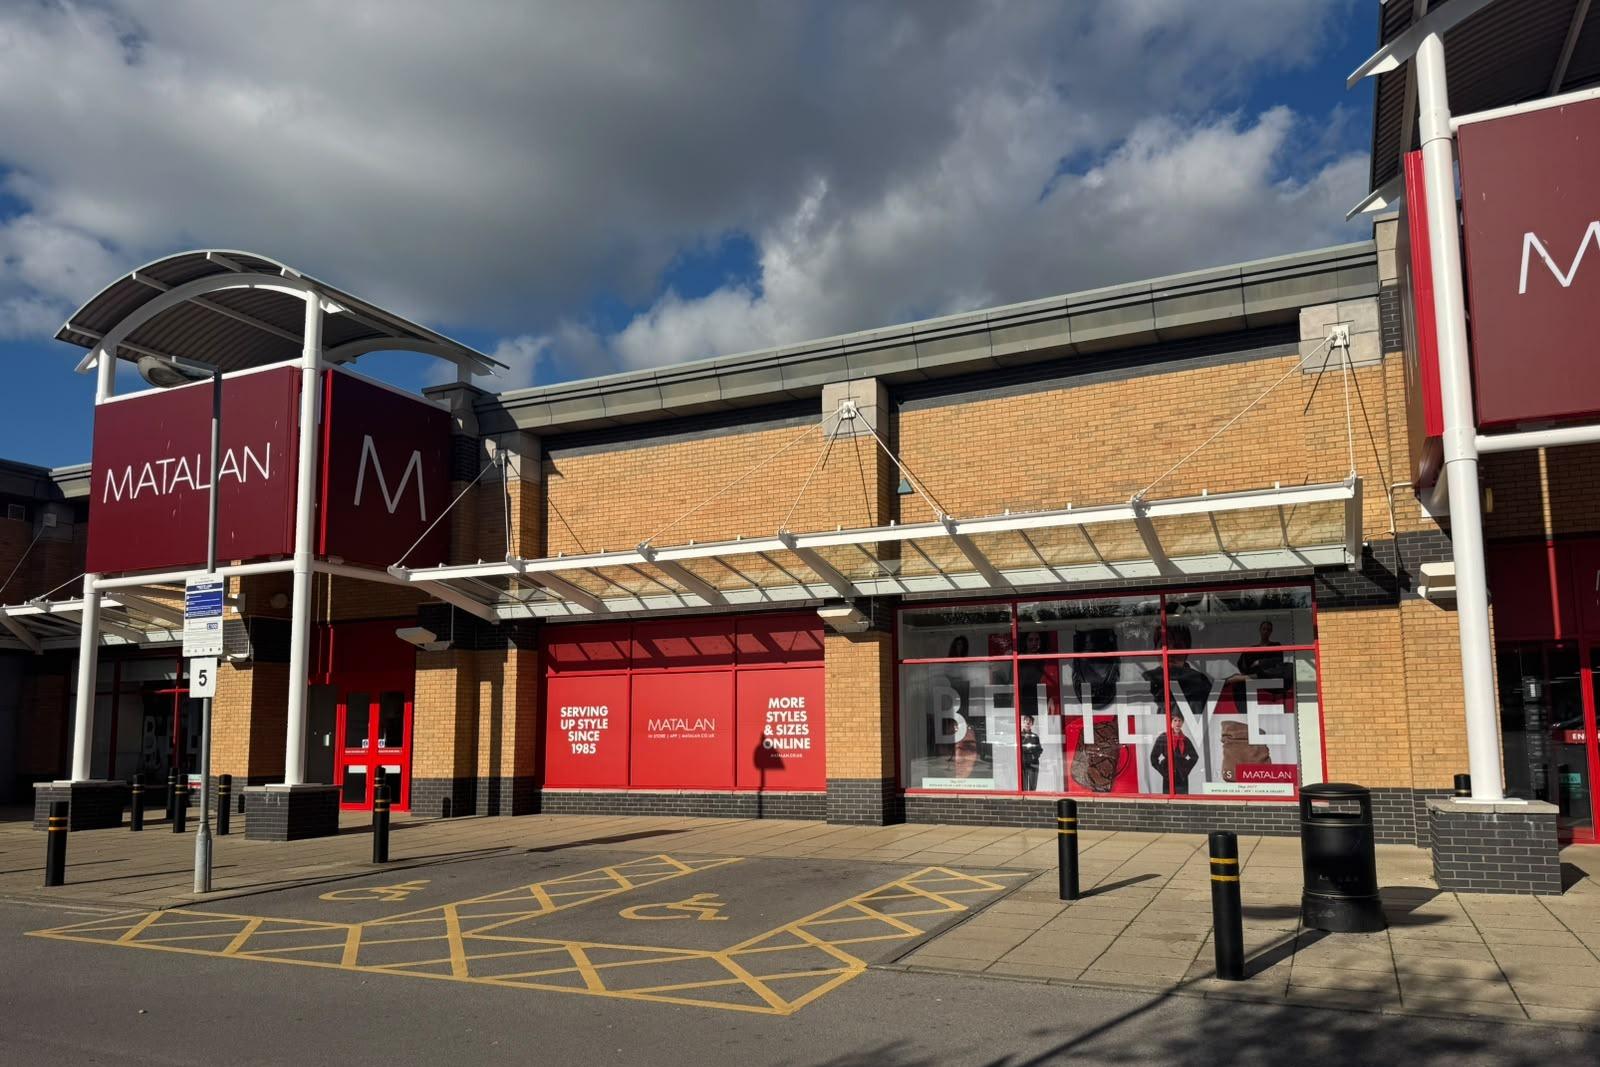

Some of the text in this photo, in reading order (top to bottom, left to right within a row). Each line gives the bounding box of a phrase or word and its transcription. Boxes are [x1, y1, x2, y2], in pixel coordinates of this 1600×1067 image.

[1518, 220, 1600, 295] M
[102, 442, 271, 503] MATALAN
[353, 434, 427, 522] M
[198, 669, 208, 687] 5
[768, 697, 805, 709] MORE
[560, 705, 609, 718] SERVING
[766, 710, 808, 723] STYLES
[933, 678, 1287, 746] BELIEVE
[560, 718, 609, 730] UP STYLE
[647, 718, 716, 731] MATALAN
[763, 723, 810, 736] & SIZES
[568, 730, 601, 742] SINCE
[571, 743, 597, 755] 1985
[763, 737, 811, 750] ONLINE
[1242, 770, 1292, 779] MATALAN
